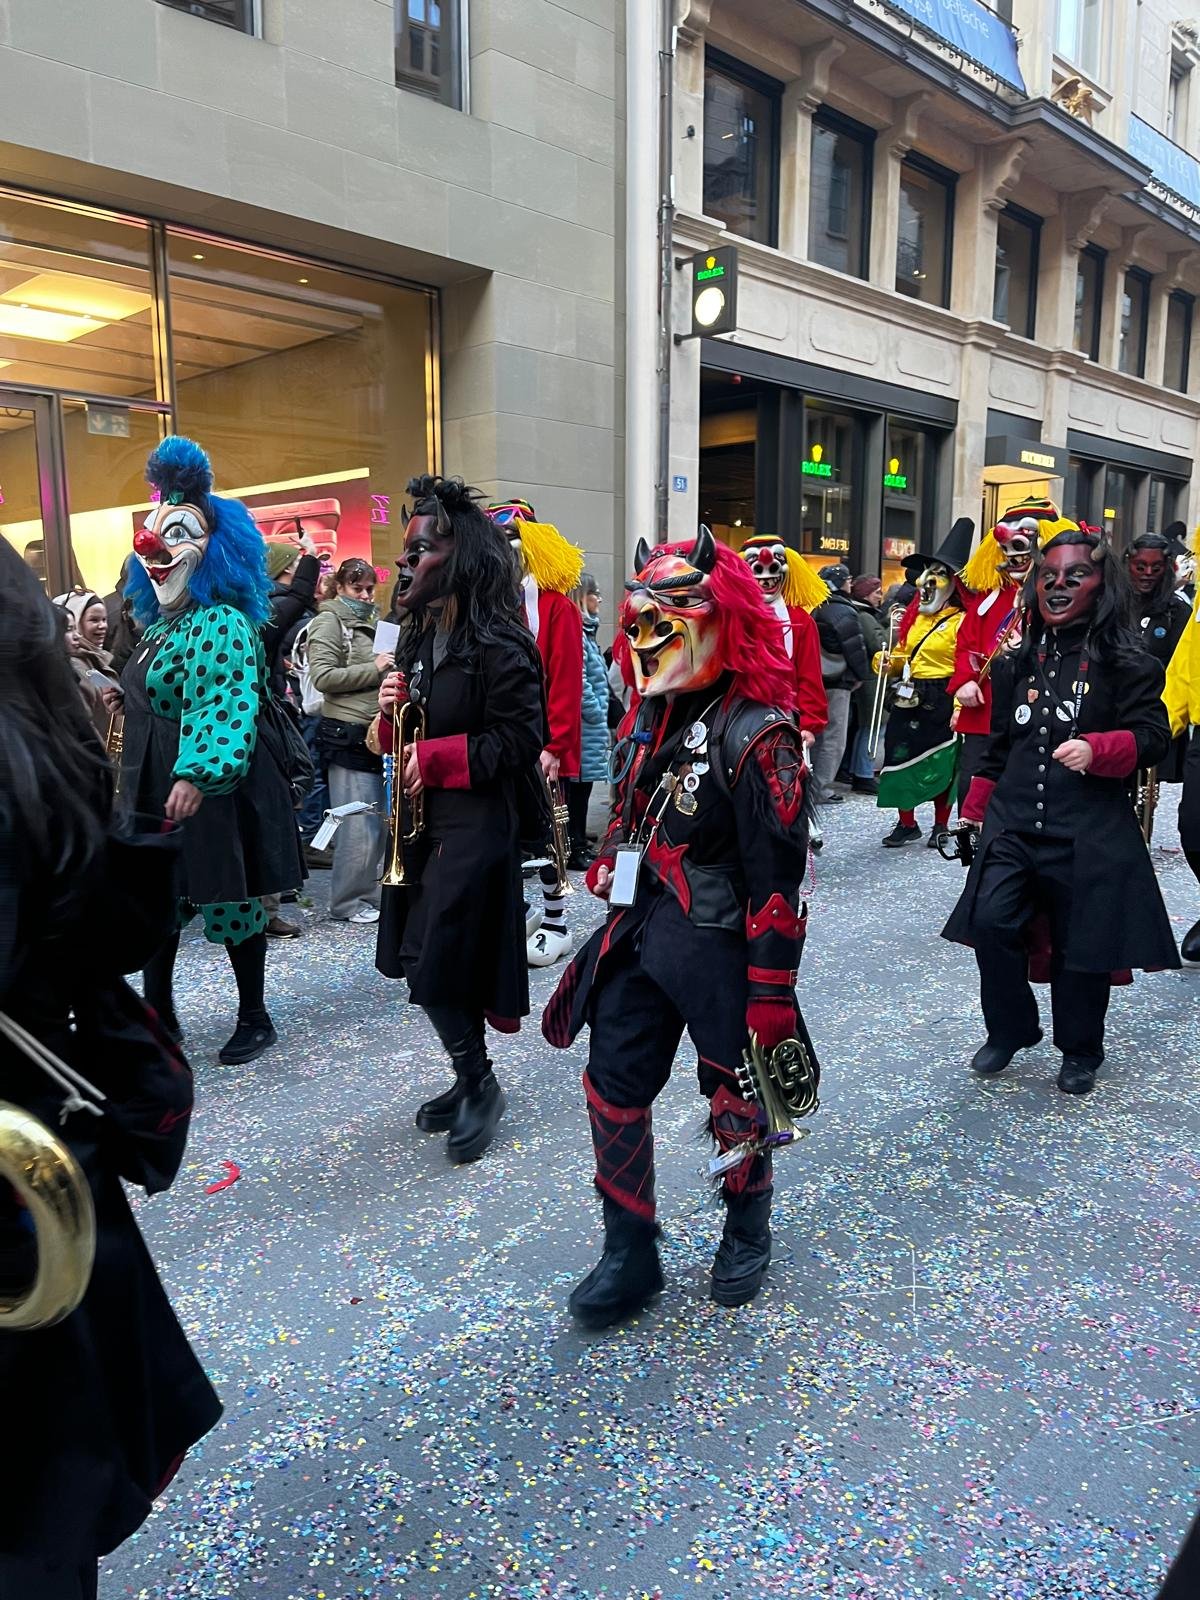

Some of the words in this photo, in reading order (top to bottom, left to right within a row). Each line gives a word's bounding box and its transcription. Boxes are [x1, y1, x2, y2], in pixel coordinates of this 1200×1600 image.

[697, 266, 725, 281] ROLEX
[801, 461, 832, 477] ROLEX
[676, 478, 685, 490] 51
